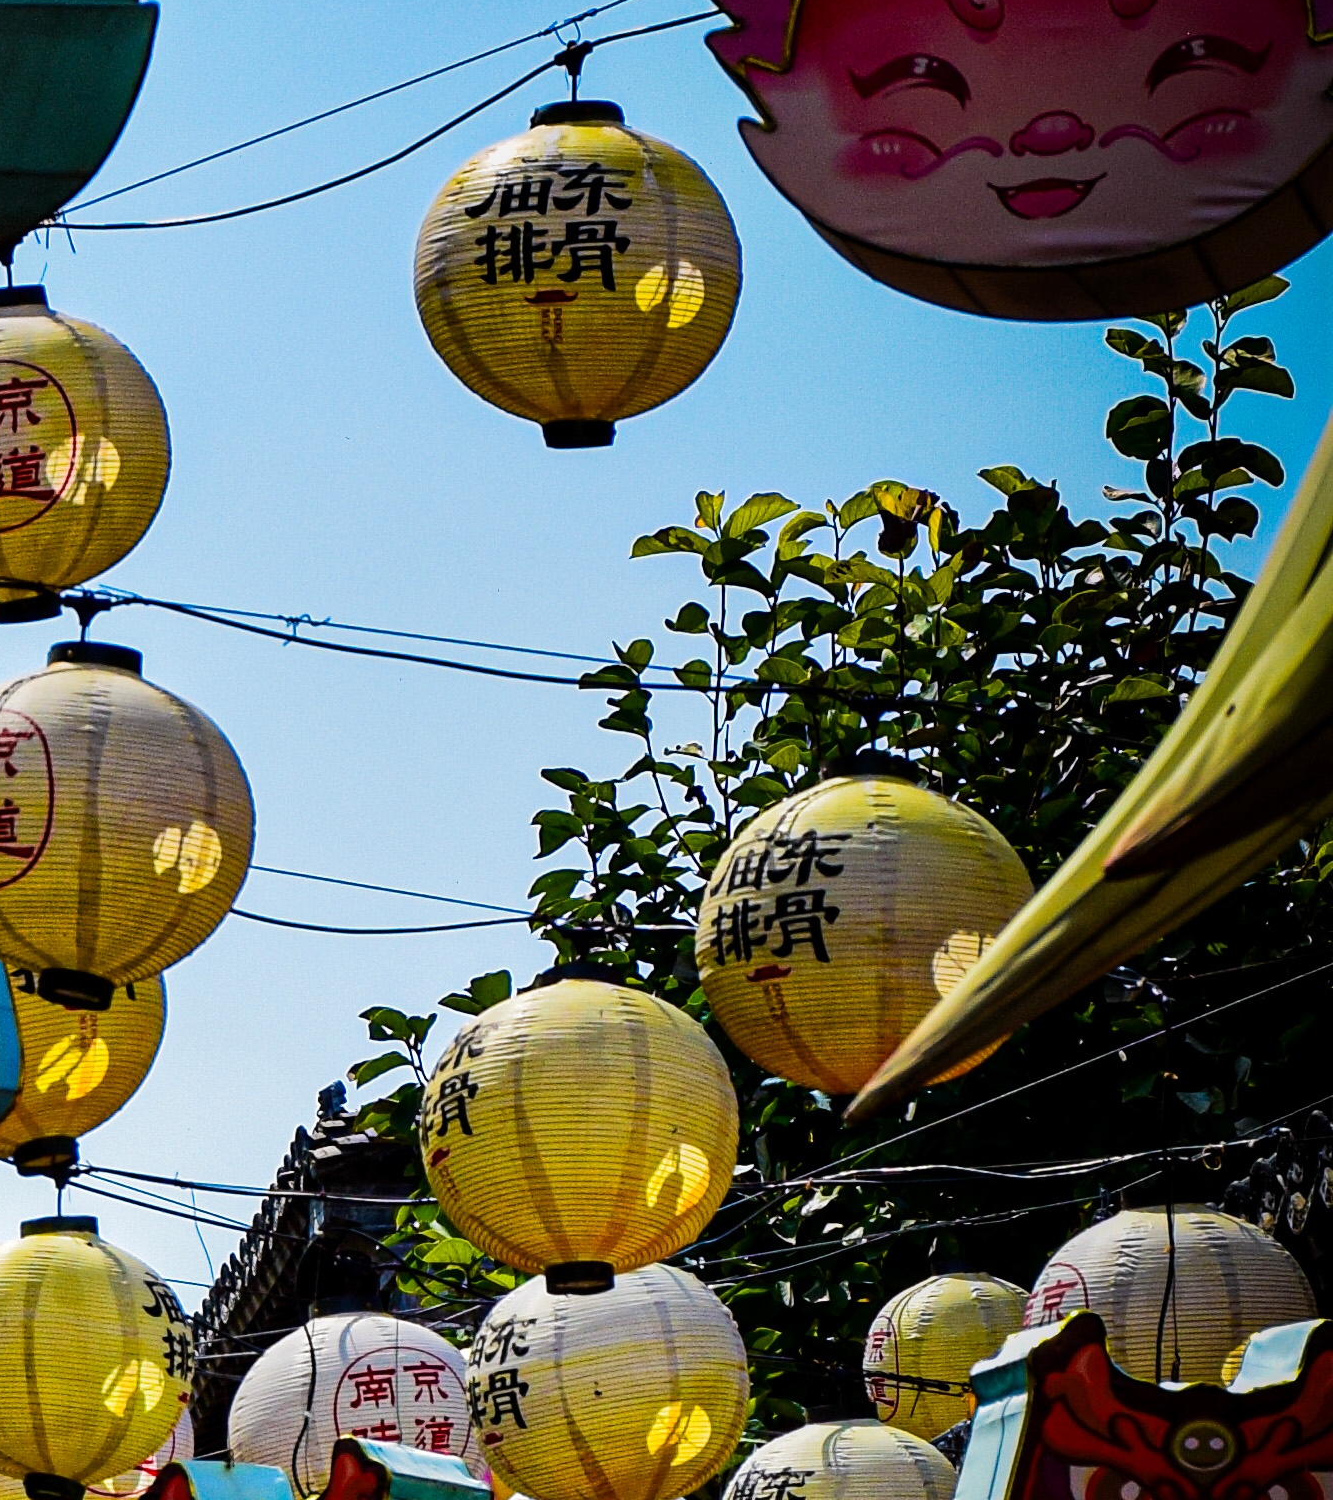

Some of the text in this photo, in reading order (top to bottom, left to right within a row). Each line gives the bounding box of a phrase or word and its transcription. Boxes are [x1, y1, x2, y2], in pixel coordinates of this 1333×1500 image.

[465, 157, 635, 219] 庙东
[474, 221, 630, 292] 排骨
[710, 829, 853, 897] 庙东
[709, 889, 840, 966] 排骨
[142, 1278, 185, 1337] 庙
[161, 1330, 193, 1385] 排
[348, 1360, 449, 1409] 南京
